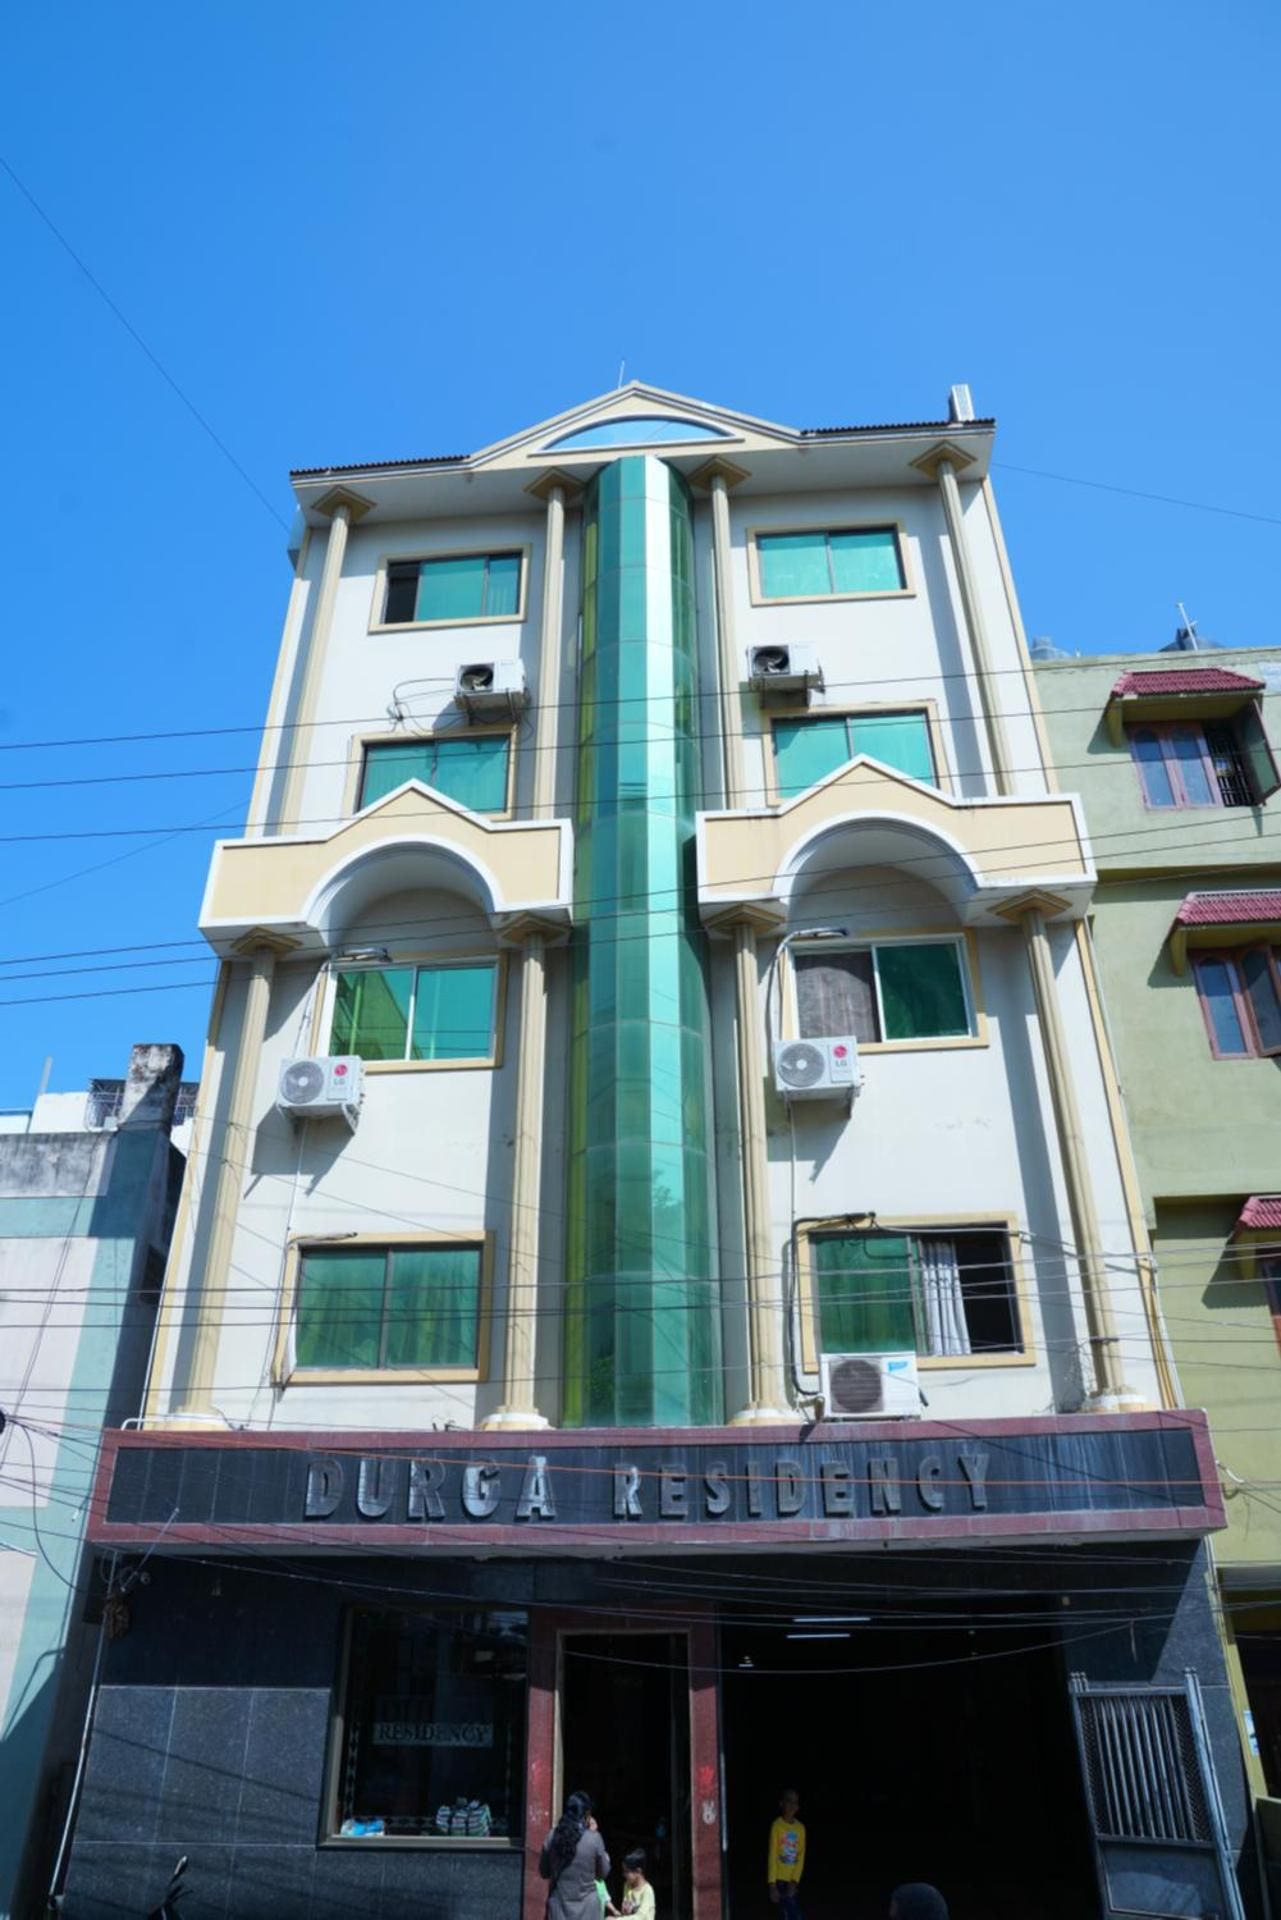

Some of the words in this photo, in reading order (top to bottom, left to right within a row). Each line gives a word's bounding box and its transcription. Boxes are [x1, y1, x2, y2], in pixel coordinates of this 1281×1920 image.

[304, 1455, 556, 1519] DURGA
[612, 1453, 989, 1519] RESIDENCY
[379, 1722, 490, 1742] RESIDENCY
